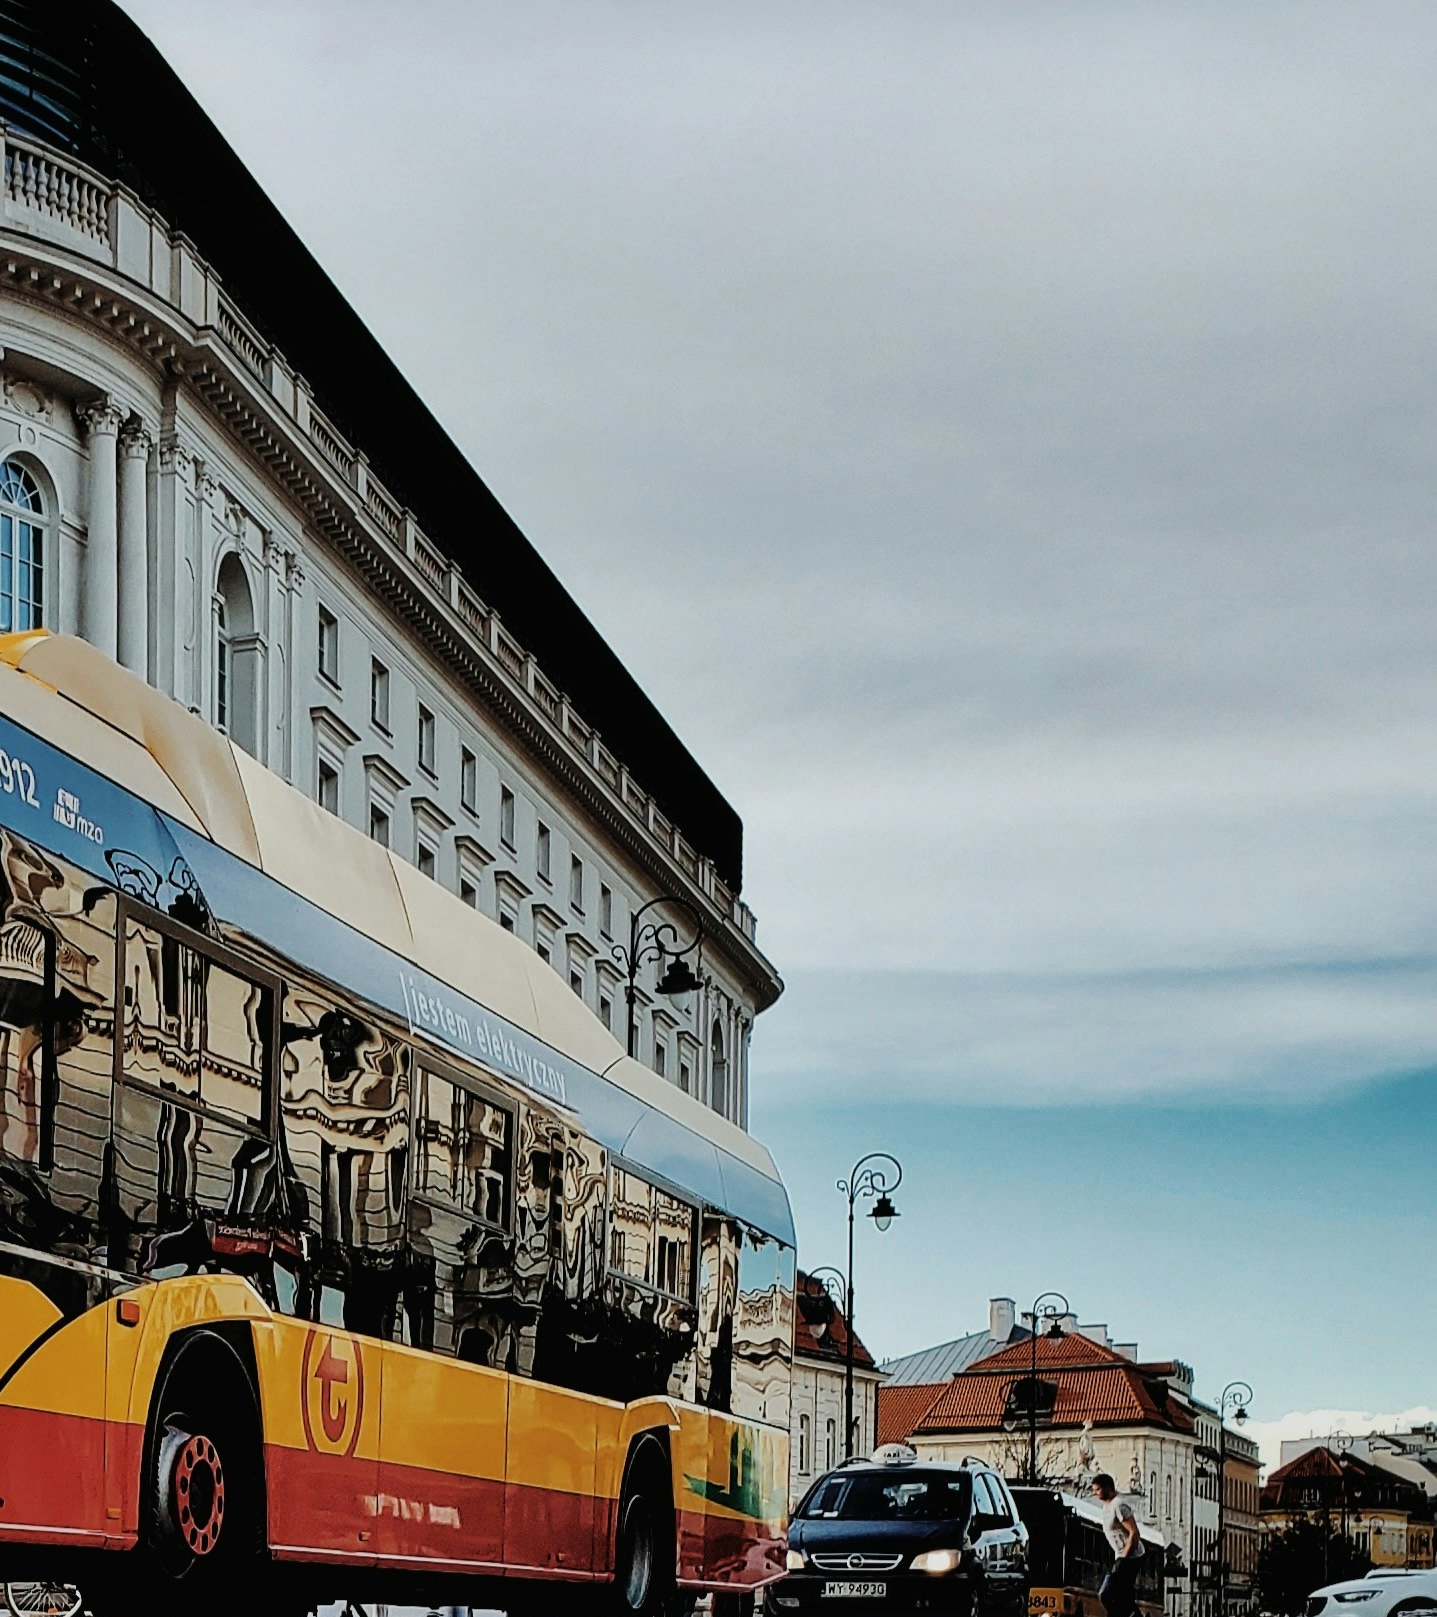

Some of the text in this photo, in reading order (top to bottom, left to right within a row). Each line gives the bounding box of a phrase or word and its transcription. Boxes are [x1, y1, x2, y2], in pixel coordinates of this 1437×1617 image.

[409, 976, 566, 1105] jestem elektryczny
[828, 1583, 843, 1594] WY
